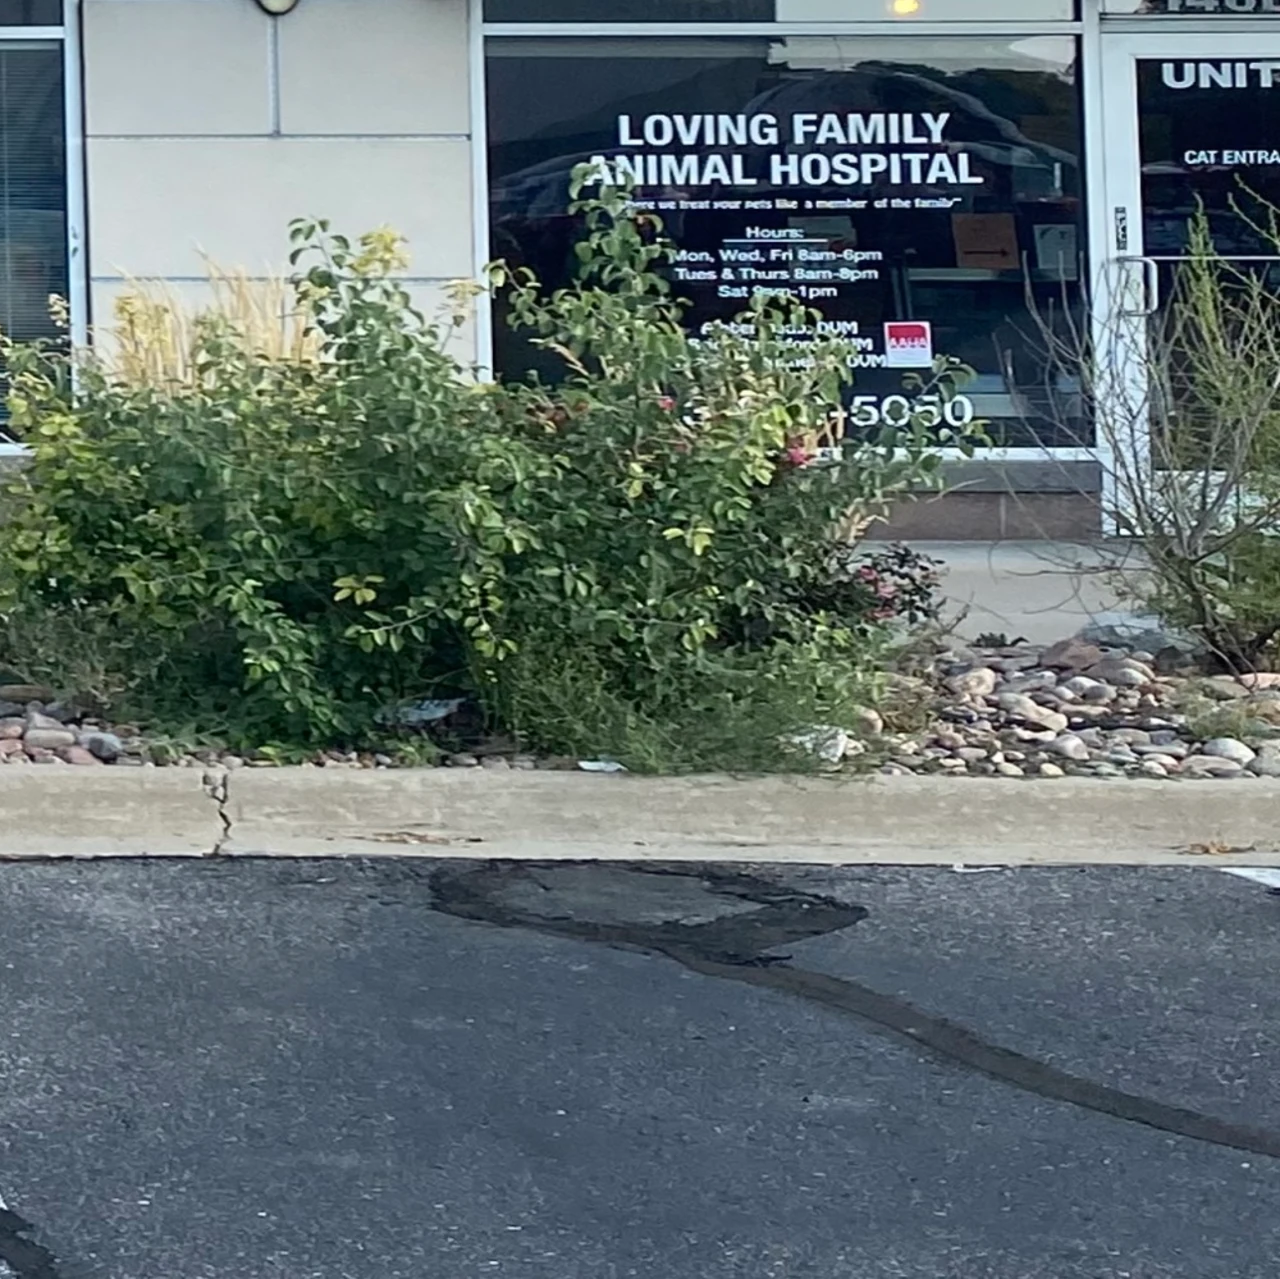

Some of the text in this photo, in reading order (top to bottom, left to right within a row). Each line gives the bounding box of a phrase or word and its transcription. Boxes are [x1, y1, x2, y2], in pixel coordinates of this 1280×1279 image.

[1162, 62, 1280, 89] UNIT
[618, 113, 950, 146] LOVING FAMILY
[1184, 150, 1280, 165] CAT ENTRA
[584, 152, 984, 186] ANIMAL HOSPITAL
[745, 226, 805, 239] Hours:
[674, 248, 883, 264] Mon, Wed, Fri 8am-6pm
[674, 267, 879, 282] Tues & Thurs 8am-8pm
[717, 285, 748, 298] Sat
